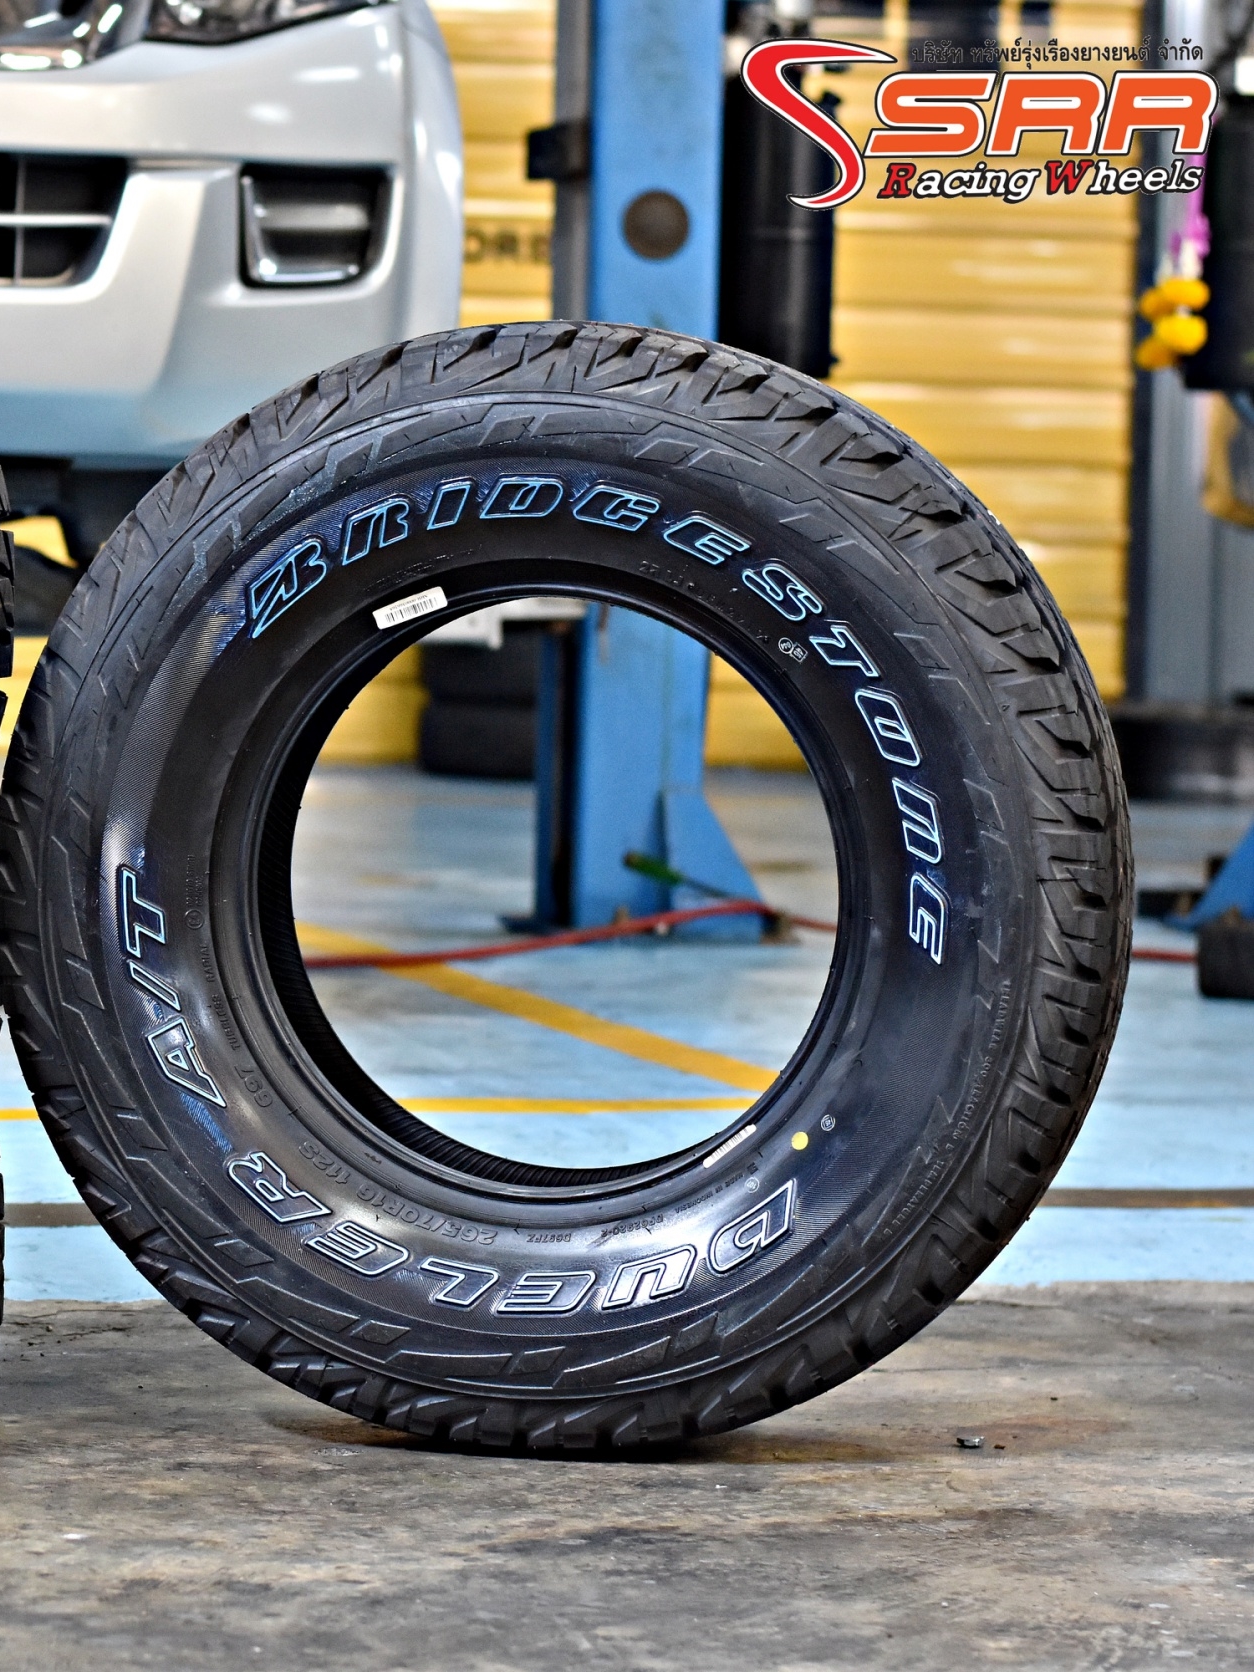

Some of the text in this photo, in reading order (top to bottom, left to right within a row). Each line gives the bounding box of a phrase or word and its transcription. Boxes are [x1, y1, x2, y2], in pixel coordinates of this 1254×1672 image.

[248, 472, 950, 965] BRIDGESTONE
[234, 1064, 274, 1109] 697
[227, 1151, 798, 1314] DUELER
[297, 1140, 498, 1246] 265/70R16 112S
